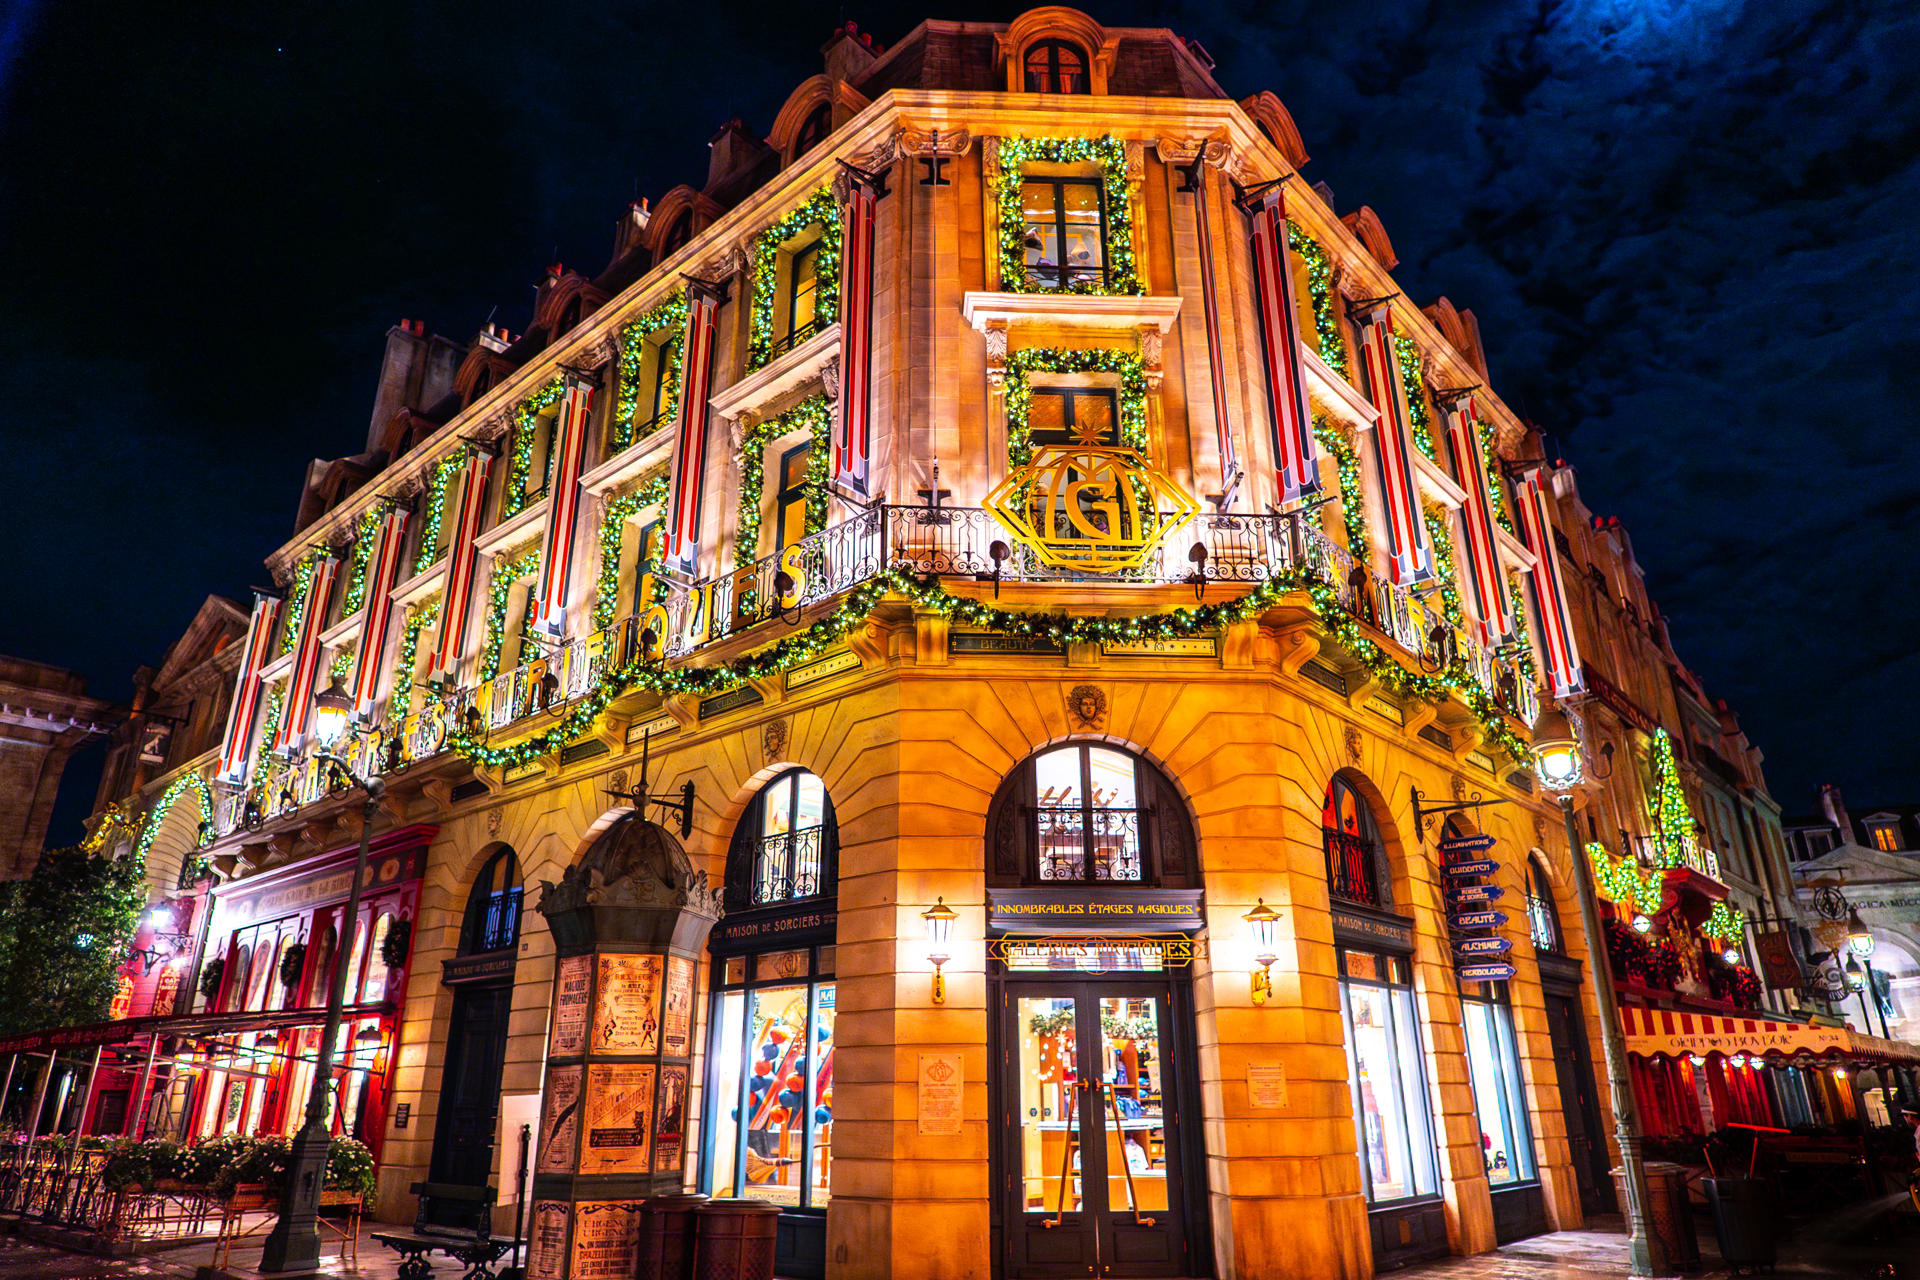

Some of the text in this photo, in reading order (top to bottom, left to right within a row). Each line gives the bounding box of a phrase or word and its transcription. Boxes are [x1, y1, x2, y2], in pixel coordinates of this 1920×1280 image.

[1449, 863, 1489, 875] QUIDDITCH
[997, 902, 1194, 914] INNOMBRABLES ÉTAGES MAGIQUES
[1338, 914, 1363, 932] MAISON
[1458, 912, 1496, 925] BEAUTÉ
[726, 924, 759, 938] MAISON
[774, 914, 821, 932] SORCIERS
[1000, 942, 1192, 957] GALERIES MIRIFIQUES
[1461, 940, 1502, 951] ALCHIMIE
[1462, 967, 1508, 977] HERBOLOGIE
